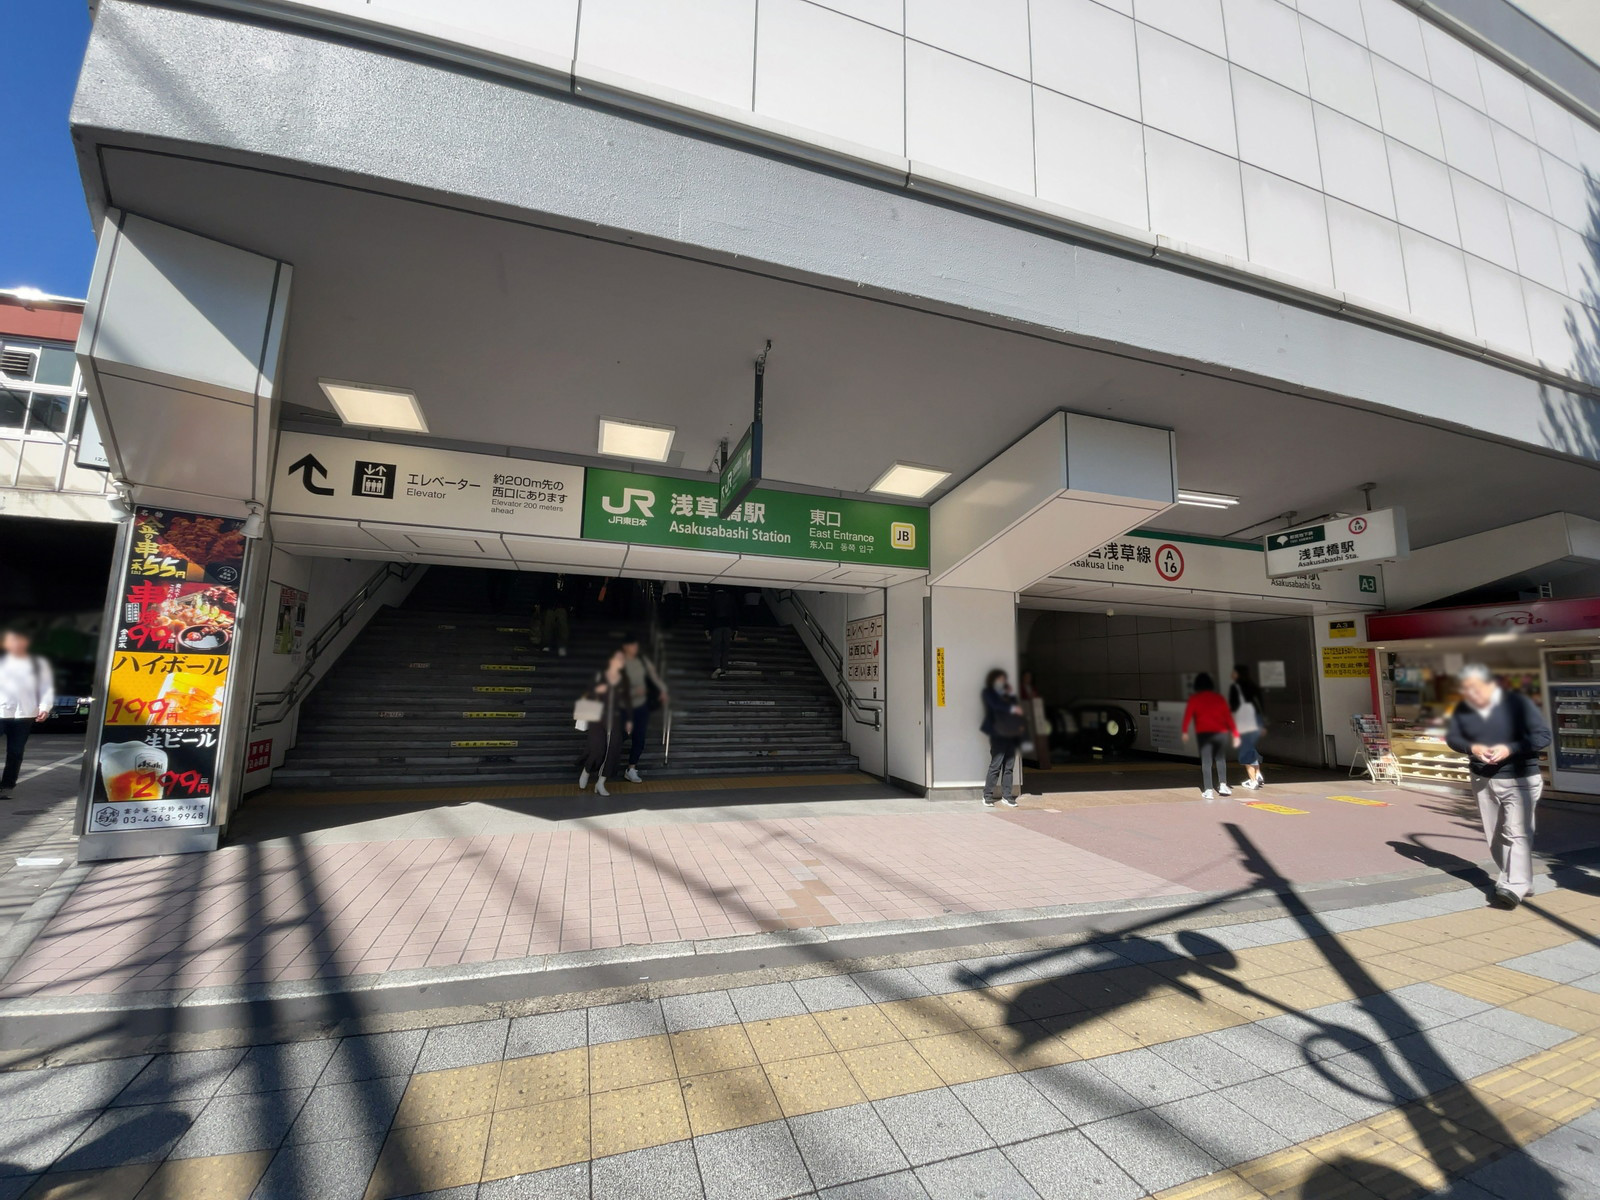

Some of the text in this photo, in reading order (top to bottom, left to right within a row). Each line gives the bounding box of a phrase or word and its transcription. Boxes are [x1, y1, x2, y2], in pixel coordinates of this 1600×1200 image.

[406, 473, 481, 491] エレベーター
[493, 473, 564, 491] 約200m先の
[406, 487, 447, 499] Elevator
[492, 486, 568, 504] 西口にあります
[491, 498, 522, 508] Elevator
[538, 504, 564, 512] meters
[602, 488, 656, 518] JR
[490, 507, 514, 515] ahead
[608, 516, 648, 527] JR東日本
[809, 509, 841, 527] 東口
[669, 520, 791, 543] Asakusabashi Station
[809, 528, 875, 543] East Entrance
[896, 530, 910, 541] JB
[809, 540, 834, 550] 东入口
[840, 543, 874, 554] 동쪽 입구
[1299, 540, 1355, 561] 浅草橋駅
[1165, 551, 1174, 560] A
[1298, 555, 1344, 568] Asakusabashi
[1070, 558, 1125, 571] Asakusa Line
[1164, 562, 1178, 573] 16
[1271, 579, 1323, 591] Asakusabashi Sta.
[1361, 578, 1375, 591] A3
[846, 622, 882, 637] エレベーター
[848, 644, 872, 657] は西口に
[112, 655, 229, 675] ハイボール
[144, 732, 217, 749] 生ビール
[137, 760, 163, 770] Asahi
[123, 811, 204, 824] 03-4363-9948
